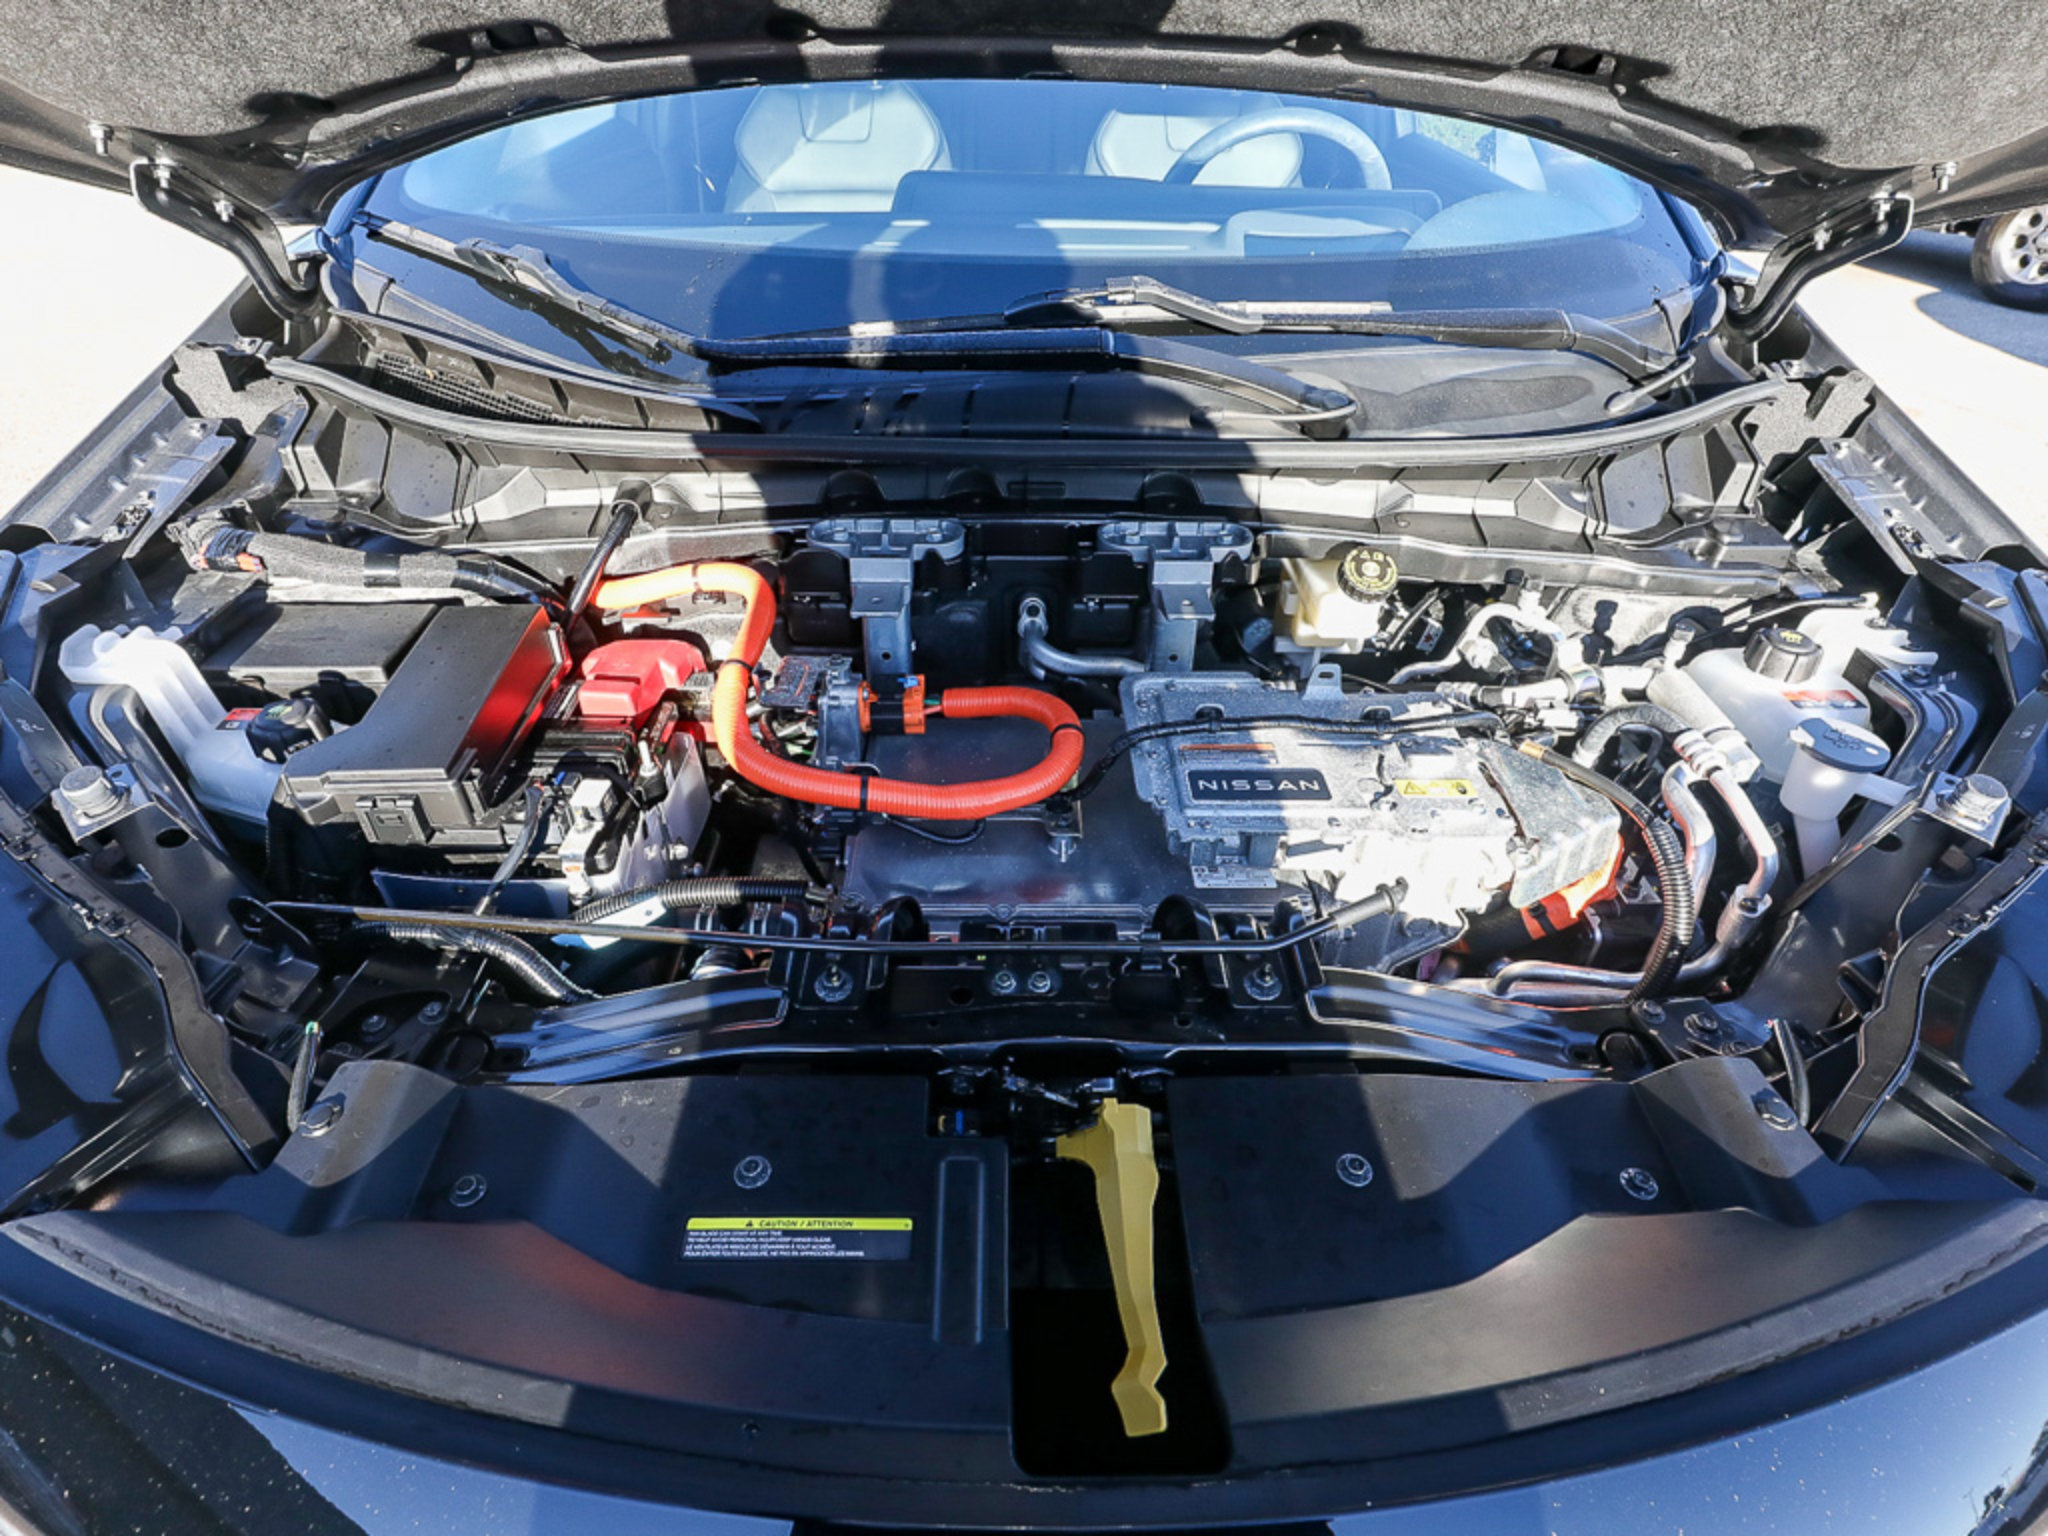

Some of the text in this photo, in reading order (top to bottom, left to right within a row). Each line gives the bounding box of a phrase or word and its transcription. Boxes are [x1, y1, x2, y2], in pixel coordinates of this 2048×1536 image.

[1197, 779, 1321, 791] NISSAN
[759, 1220, 797, 1228] CAUTION
[806, 1220, 854, 1228] ATTENTION
